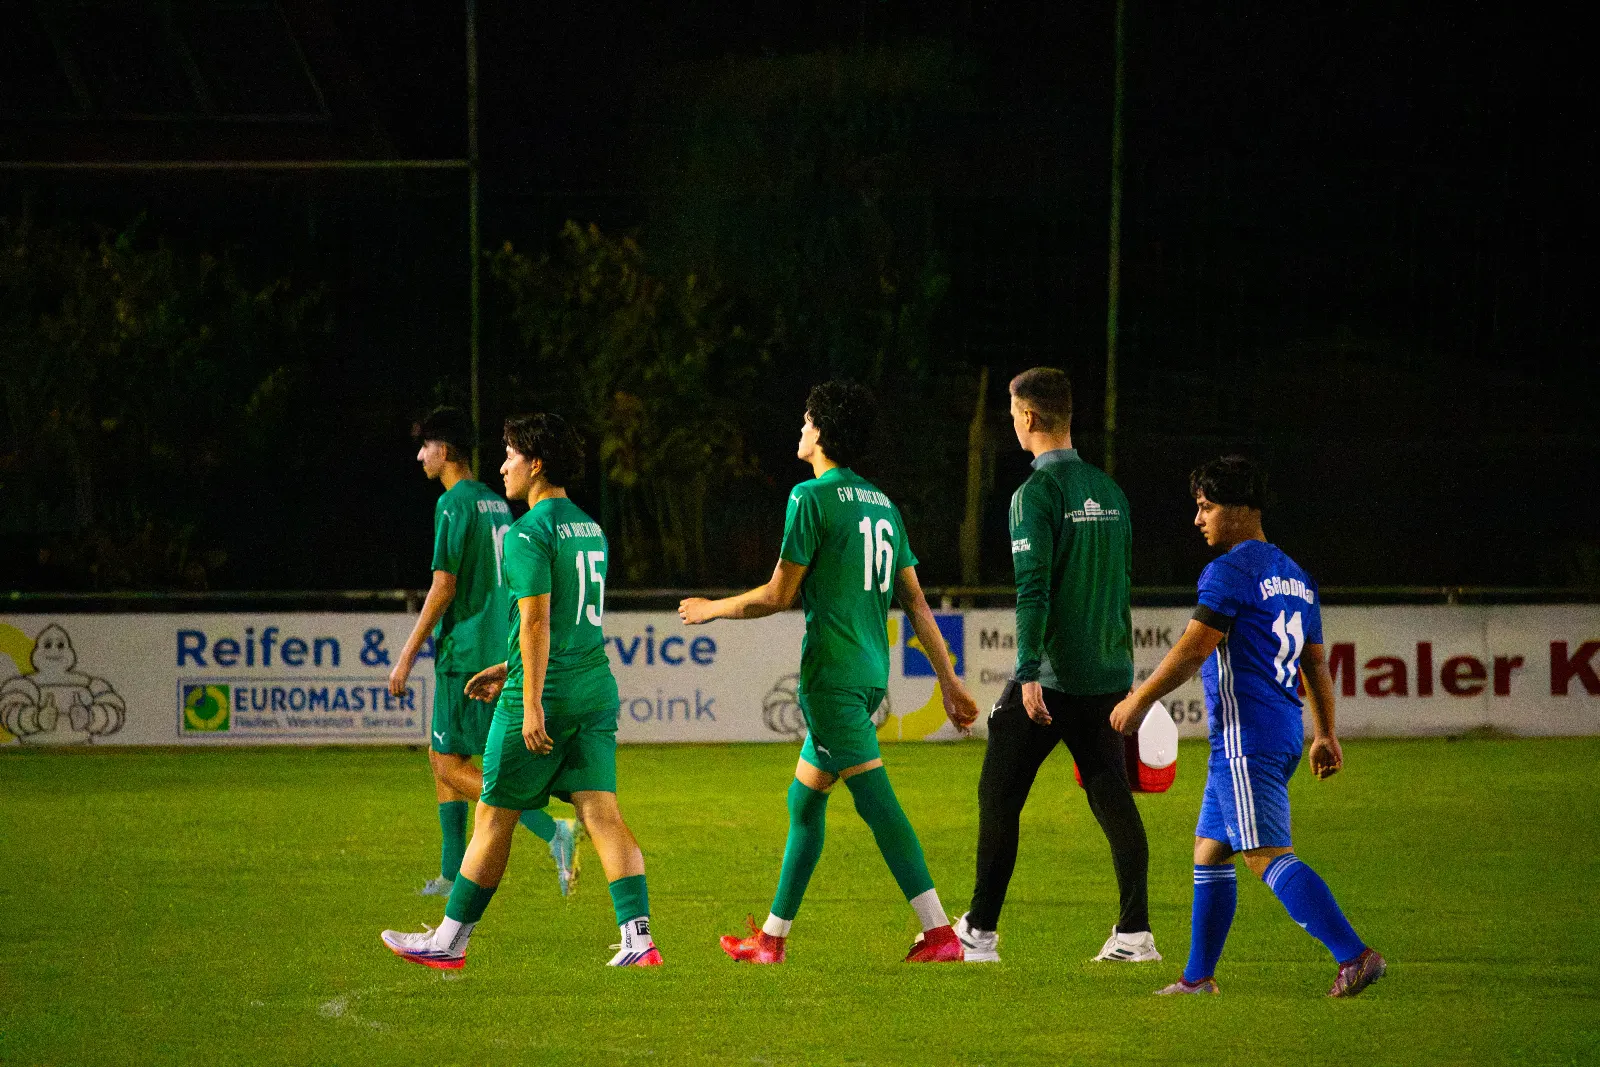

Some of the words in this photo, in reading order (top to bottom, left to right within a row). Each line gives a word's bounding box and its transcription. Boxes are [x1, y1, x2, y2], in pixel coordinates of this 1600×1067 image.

[837, 486, 854, 503] GW
[858, 516, 894, 593] 16
[575, 550, 605, 627] 15
[176, 627, 341, 668] Reifen
[359, 628, 392, 667] &
[979, 628, 1014, 650] Ma
[1271, 609, 1305, 688] 11
[1297, 640, 1525, 698] Maler
[1550, 640, 1600, 697] K
[233, 685, 416, 712] EUROMASTER
